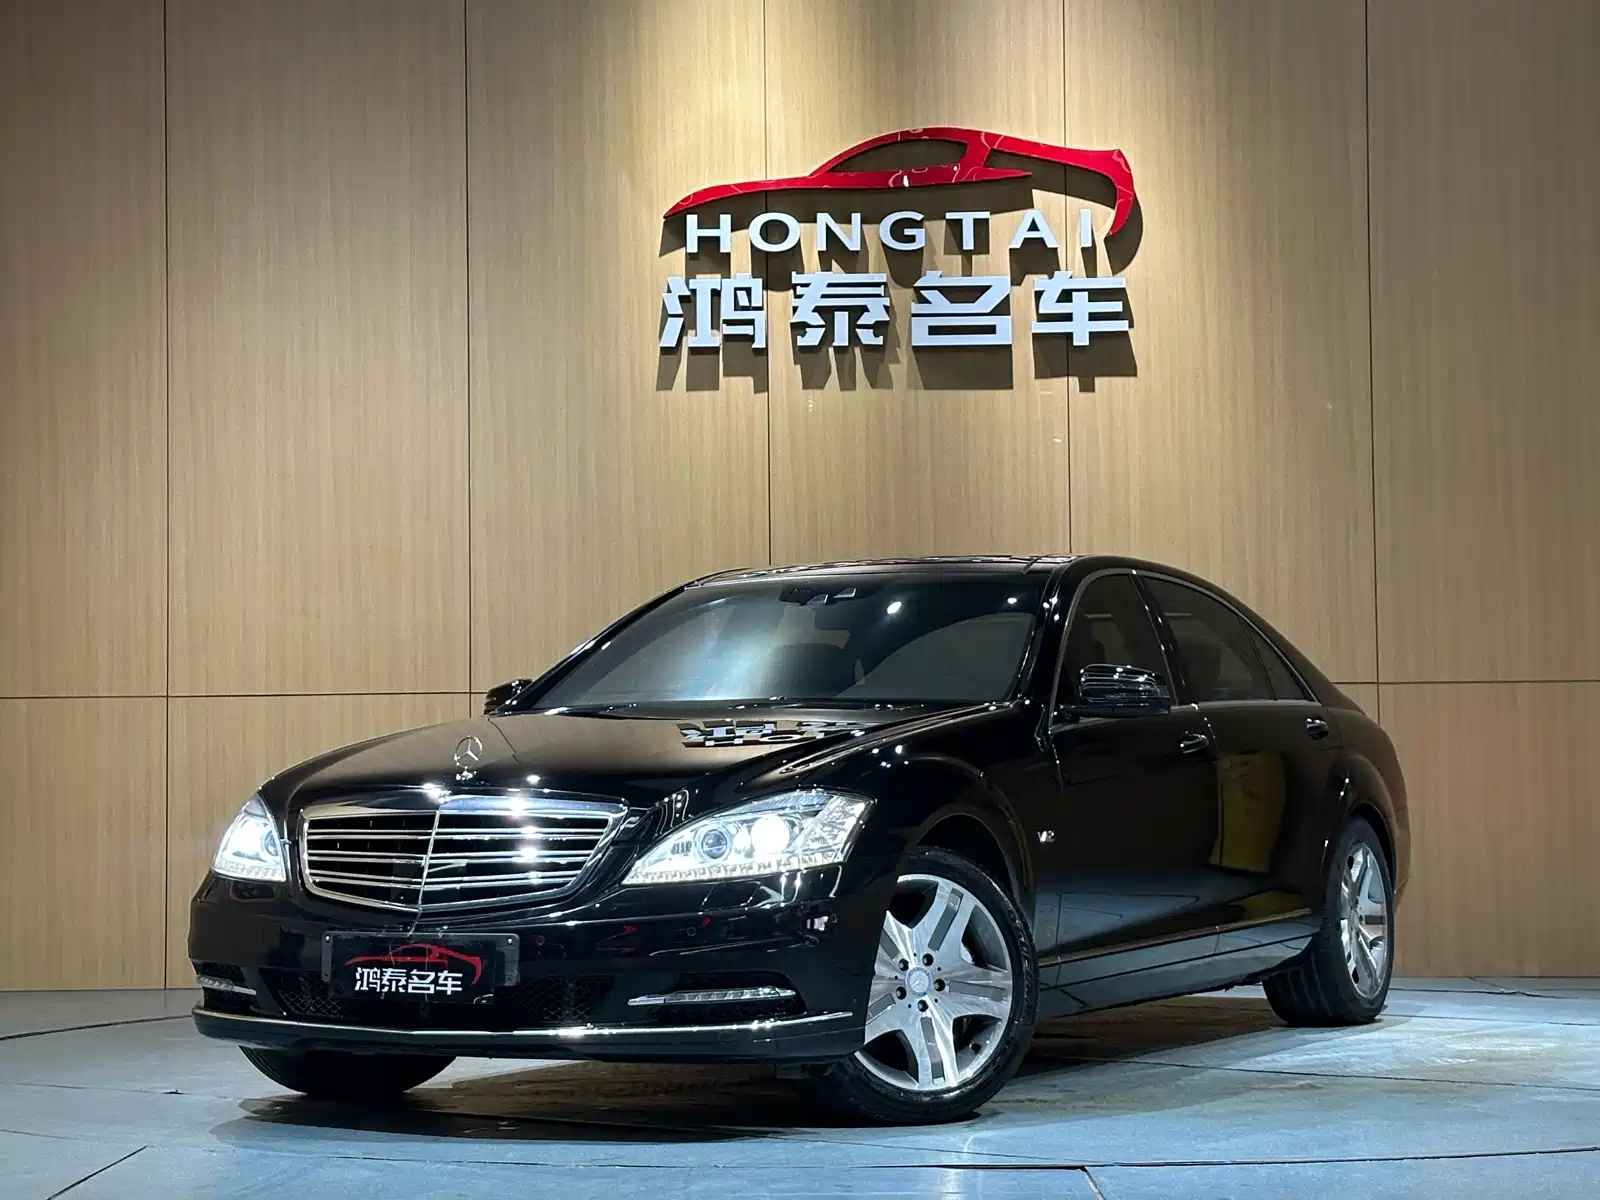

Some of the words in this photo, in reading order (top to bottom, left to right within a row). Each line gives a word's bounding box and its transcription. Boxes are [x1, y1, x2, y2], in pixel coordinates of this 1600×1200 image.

[685, 208, 1093, 254] HONGTAI
[659, 270, 1129, 349] 鸿泰名车
[354, 967, 463, 995] 鸿泰名车
